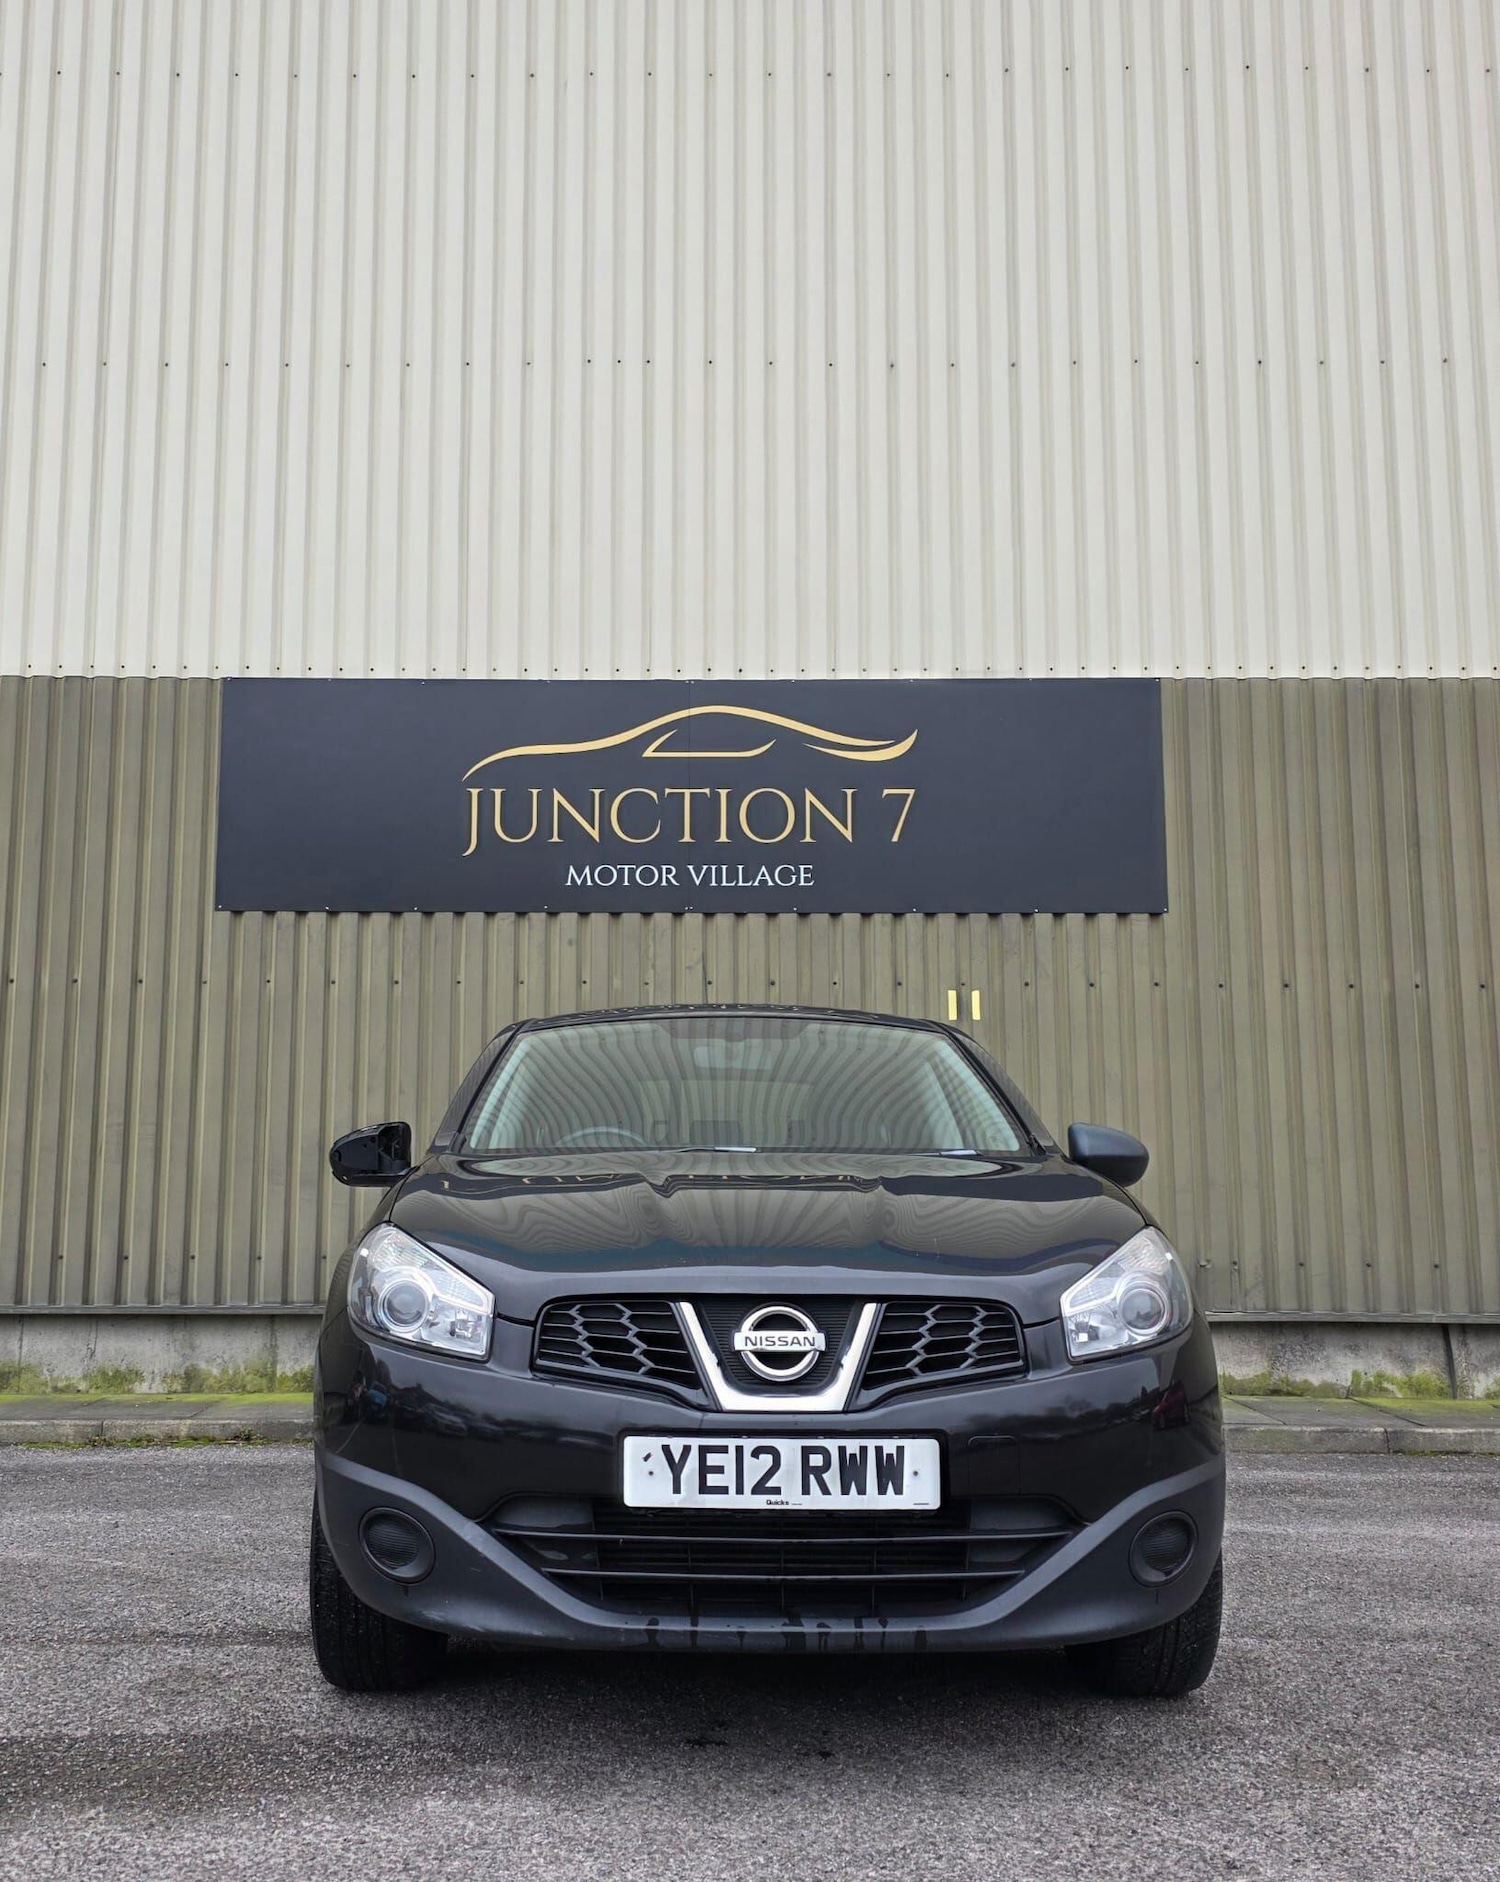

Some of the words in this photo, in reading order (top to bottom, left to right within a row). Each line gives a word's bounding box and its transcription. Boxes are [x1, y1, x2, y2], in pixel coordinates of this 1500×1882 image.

[462, 787, 859, 857] JUNCTION
[881, 787, 917, 843] 7
[564, 864, 680, 887] MOTOR
[687, 864, 815, 887] VILLAGE
[744, 1335, 816, 1347] NISSAN
[661, 1444, 782, 1496] YE12
[801, 1445, 905, 1496] RWW
